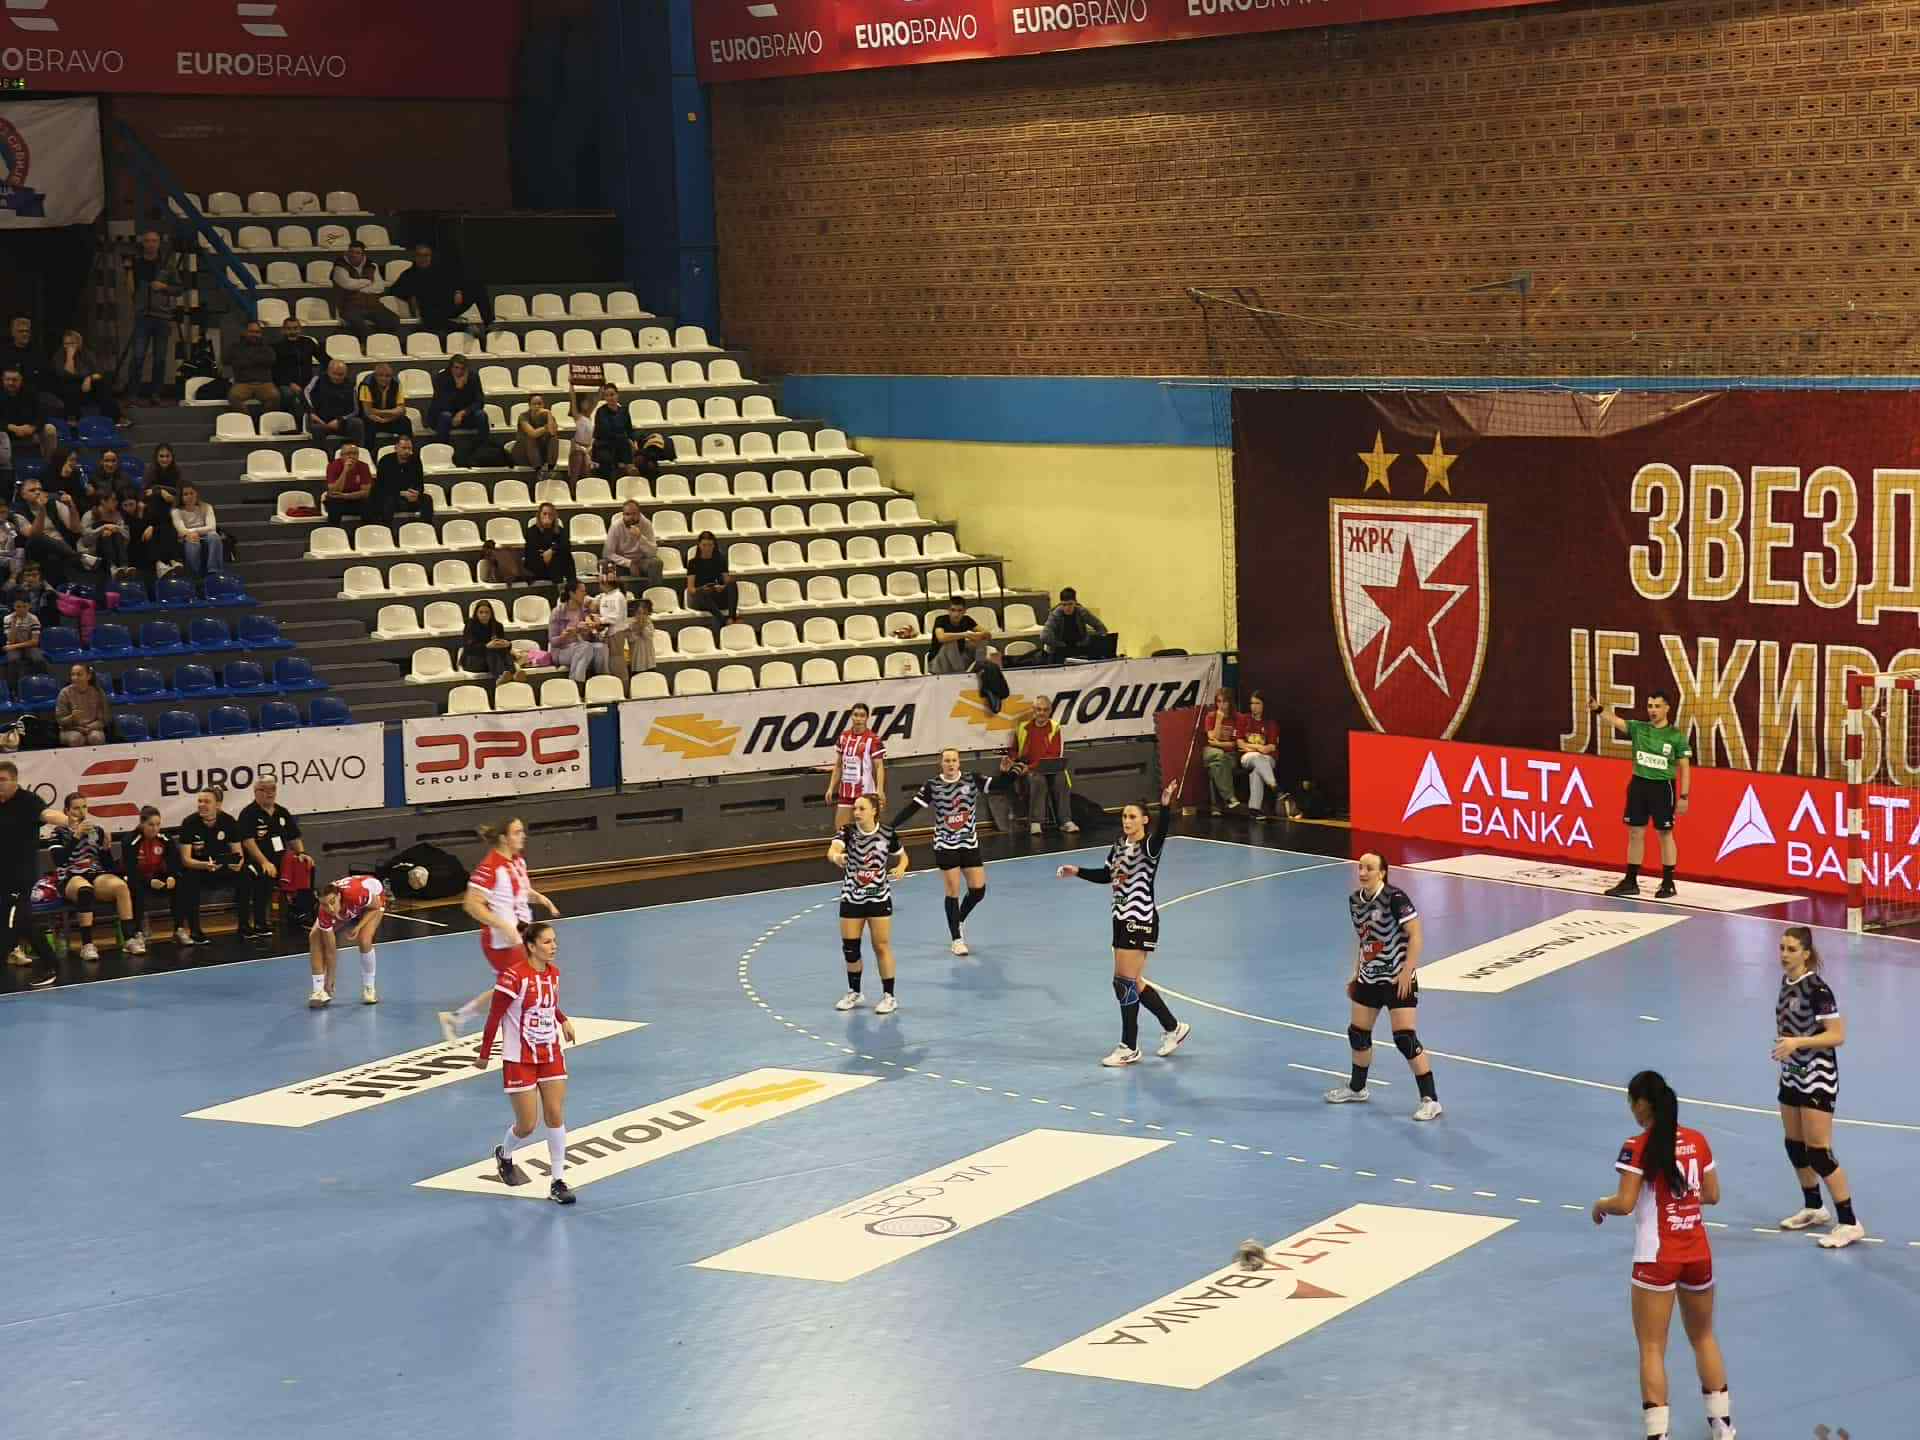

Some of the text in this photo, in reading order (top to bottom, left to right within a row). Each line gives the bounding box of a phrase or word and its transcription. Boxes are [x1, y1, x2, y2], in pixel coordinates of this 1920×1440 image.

[855, 14, 977, 49] EUROBRAVO
[1012, 4, 1147, 33] EUROBRAVO
[176, 52, 346, 78] EUROBRAVO
[710, 30, 823, 63] EUROBRAVO
[1347, 526, 1394, 554] ЖРК
[1629, 463, 1920, 625] ЗВЕЗД
[1050, 679, 1201, 726] ПОШТА
[743, 703, 916, 754] ПОШТА
[160, 755, 366, 797] EUROBRAVO
[415, 764, 581, 786] GROUP BEOGRAD
[1462, 754, 1594, 808] ALTA
[1461, 802, 1594, 849] BANKA
[1787, 841, 1920, 891] BANK
